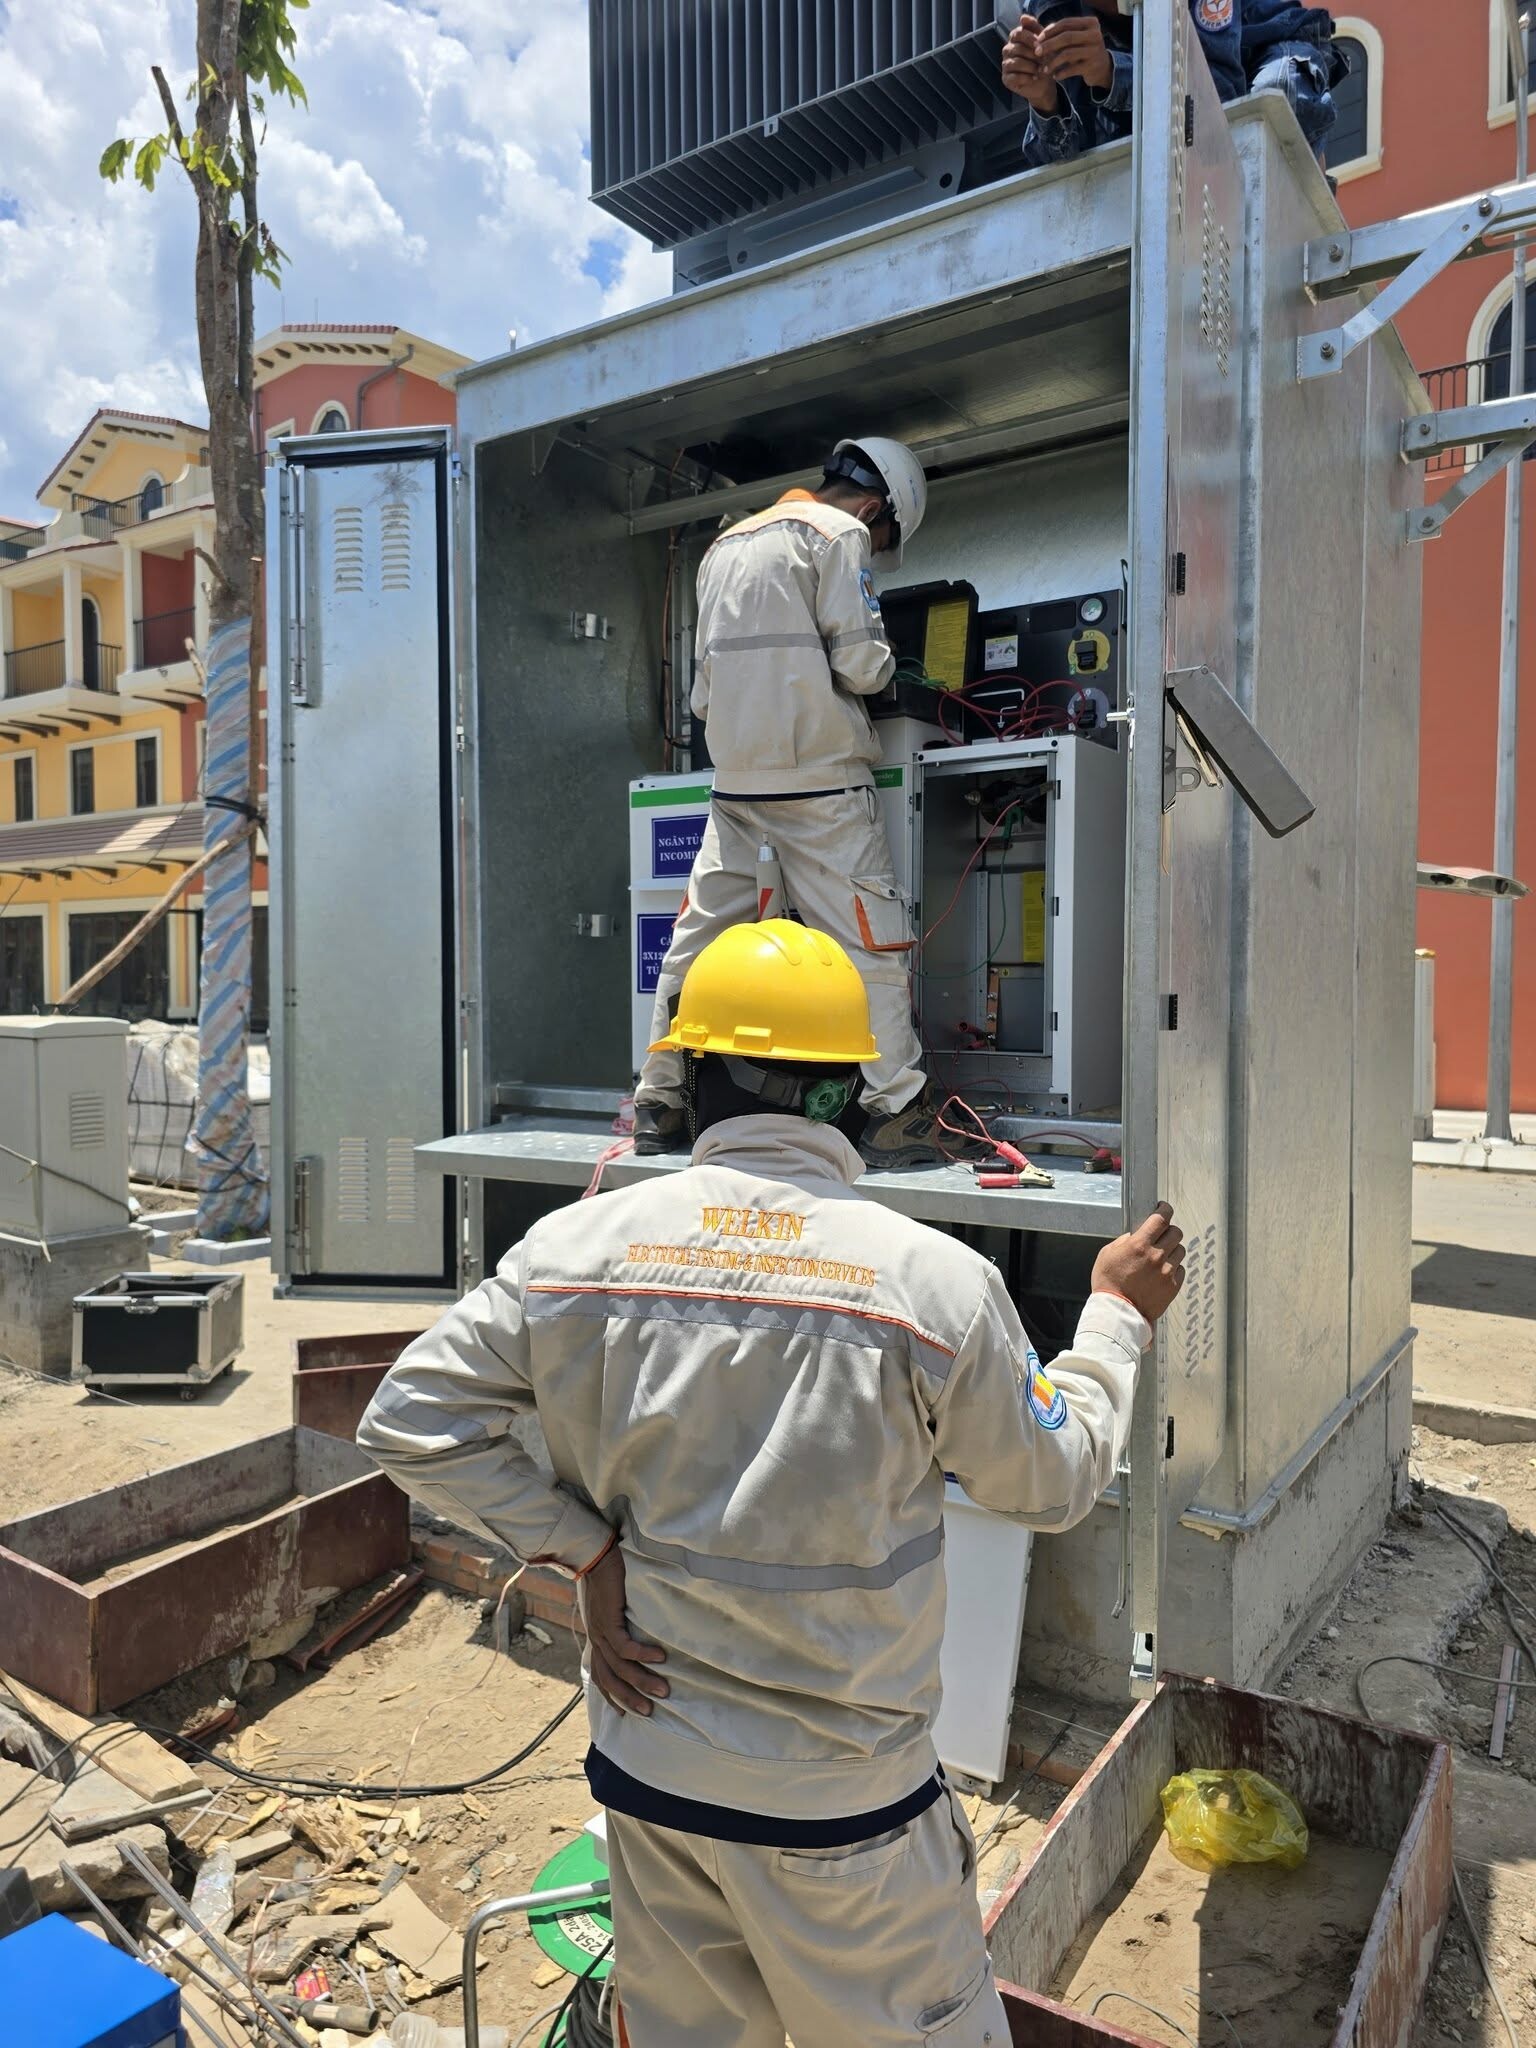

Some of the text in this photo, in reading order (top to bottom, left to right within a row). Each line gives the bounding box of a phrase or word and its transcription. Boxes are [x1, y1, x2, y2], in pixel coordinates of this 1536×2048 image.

[686, 833, 699, 845] TỦ
[702, 1206, 807, 1241] WELKIN
[627, 1245, 875, 1287] ELECTRICAL TESTING & INSPECTION SERVICES
[575, 1931, 603, 1952] 25A
